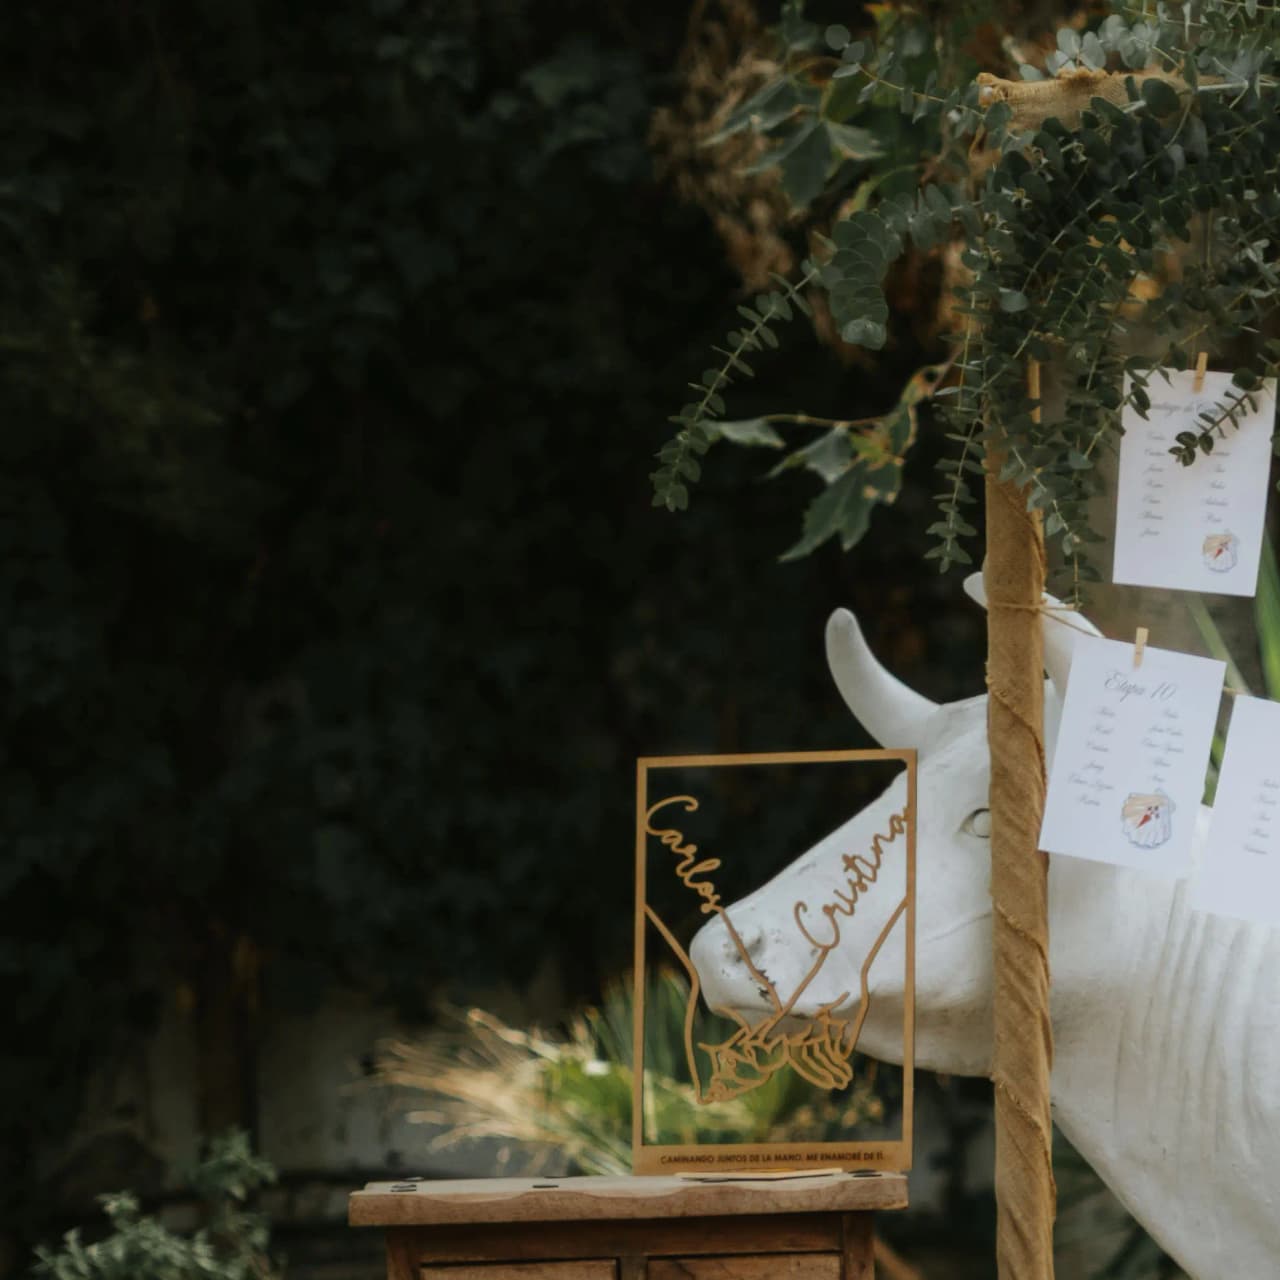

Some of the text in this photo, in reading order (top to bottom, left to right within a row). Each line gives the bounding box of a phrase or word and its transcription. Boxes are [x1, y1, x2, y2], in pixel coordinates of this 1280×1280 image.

[1105, 670, 1176, 703] Etapa 10
[644, 795, 722, 914] Carlos
[763, 1154, 771, 1162] LA
